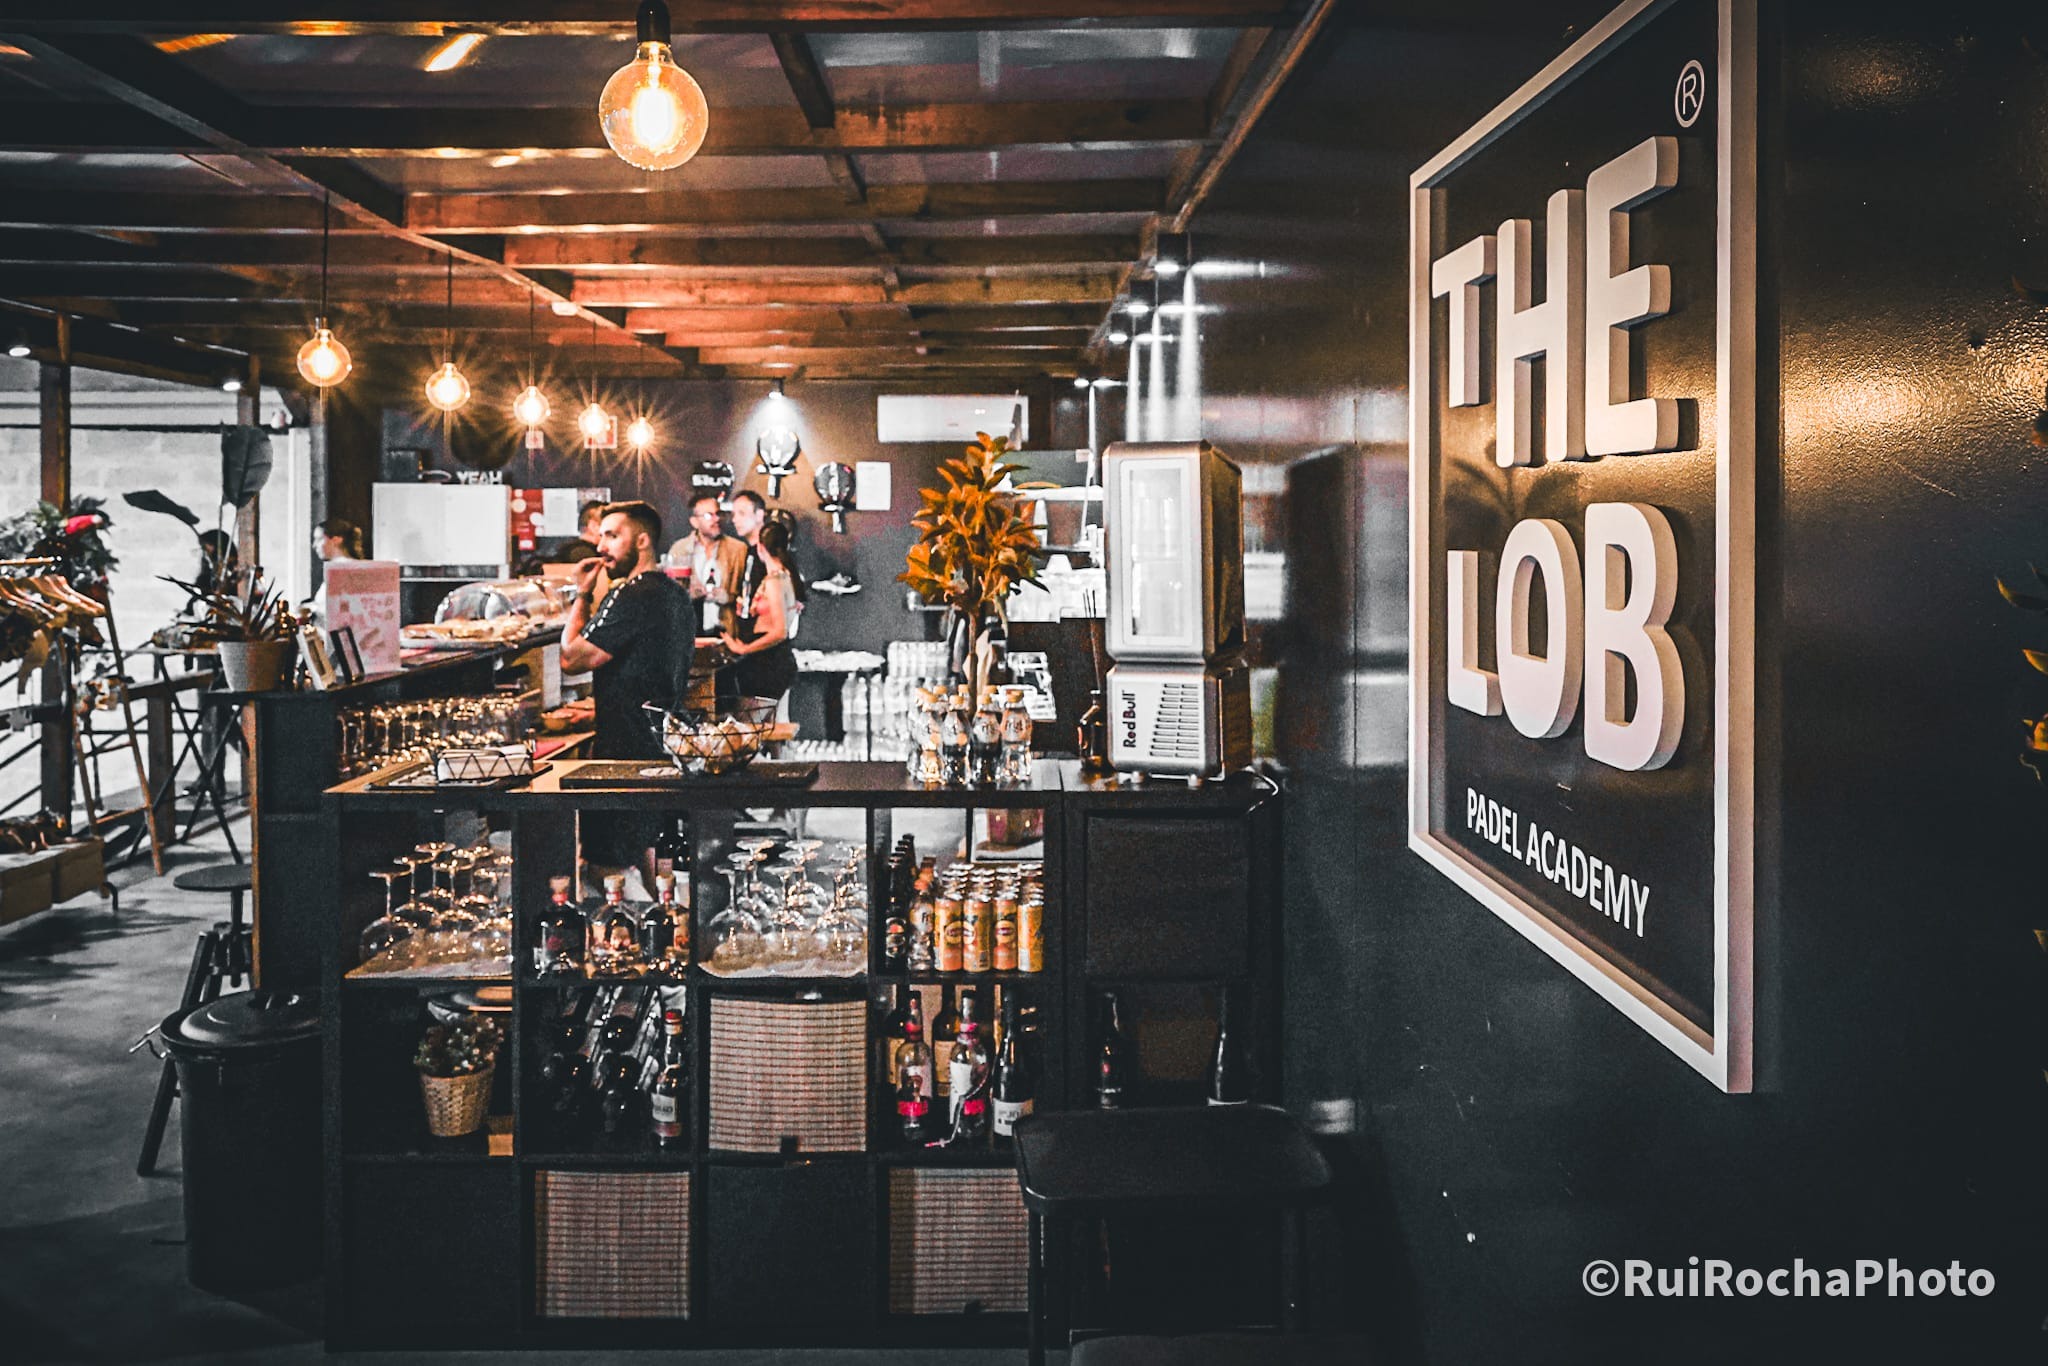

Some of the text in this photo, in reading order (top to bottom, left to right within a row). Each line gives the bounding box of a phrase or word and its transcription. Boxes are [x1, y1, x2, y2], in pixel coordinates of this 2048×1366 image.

[1432, 136, 1679, 468] THE
[456, 470, 503, 485] YEAH
[1447, 502, 1685, 771] LOB
[1467, 787, 1650, 937] PADEL ACADEMY
